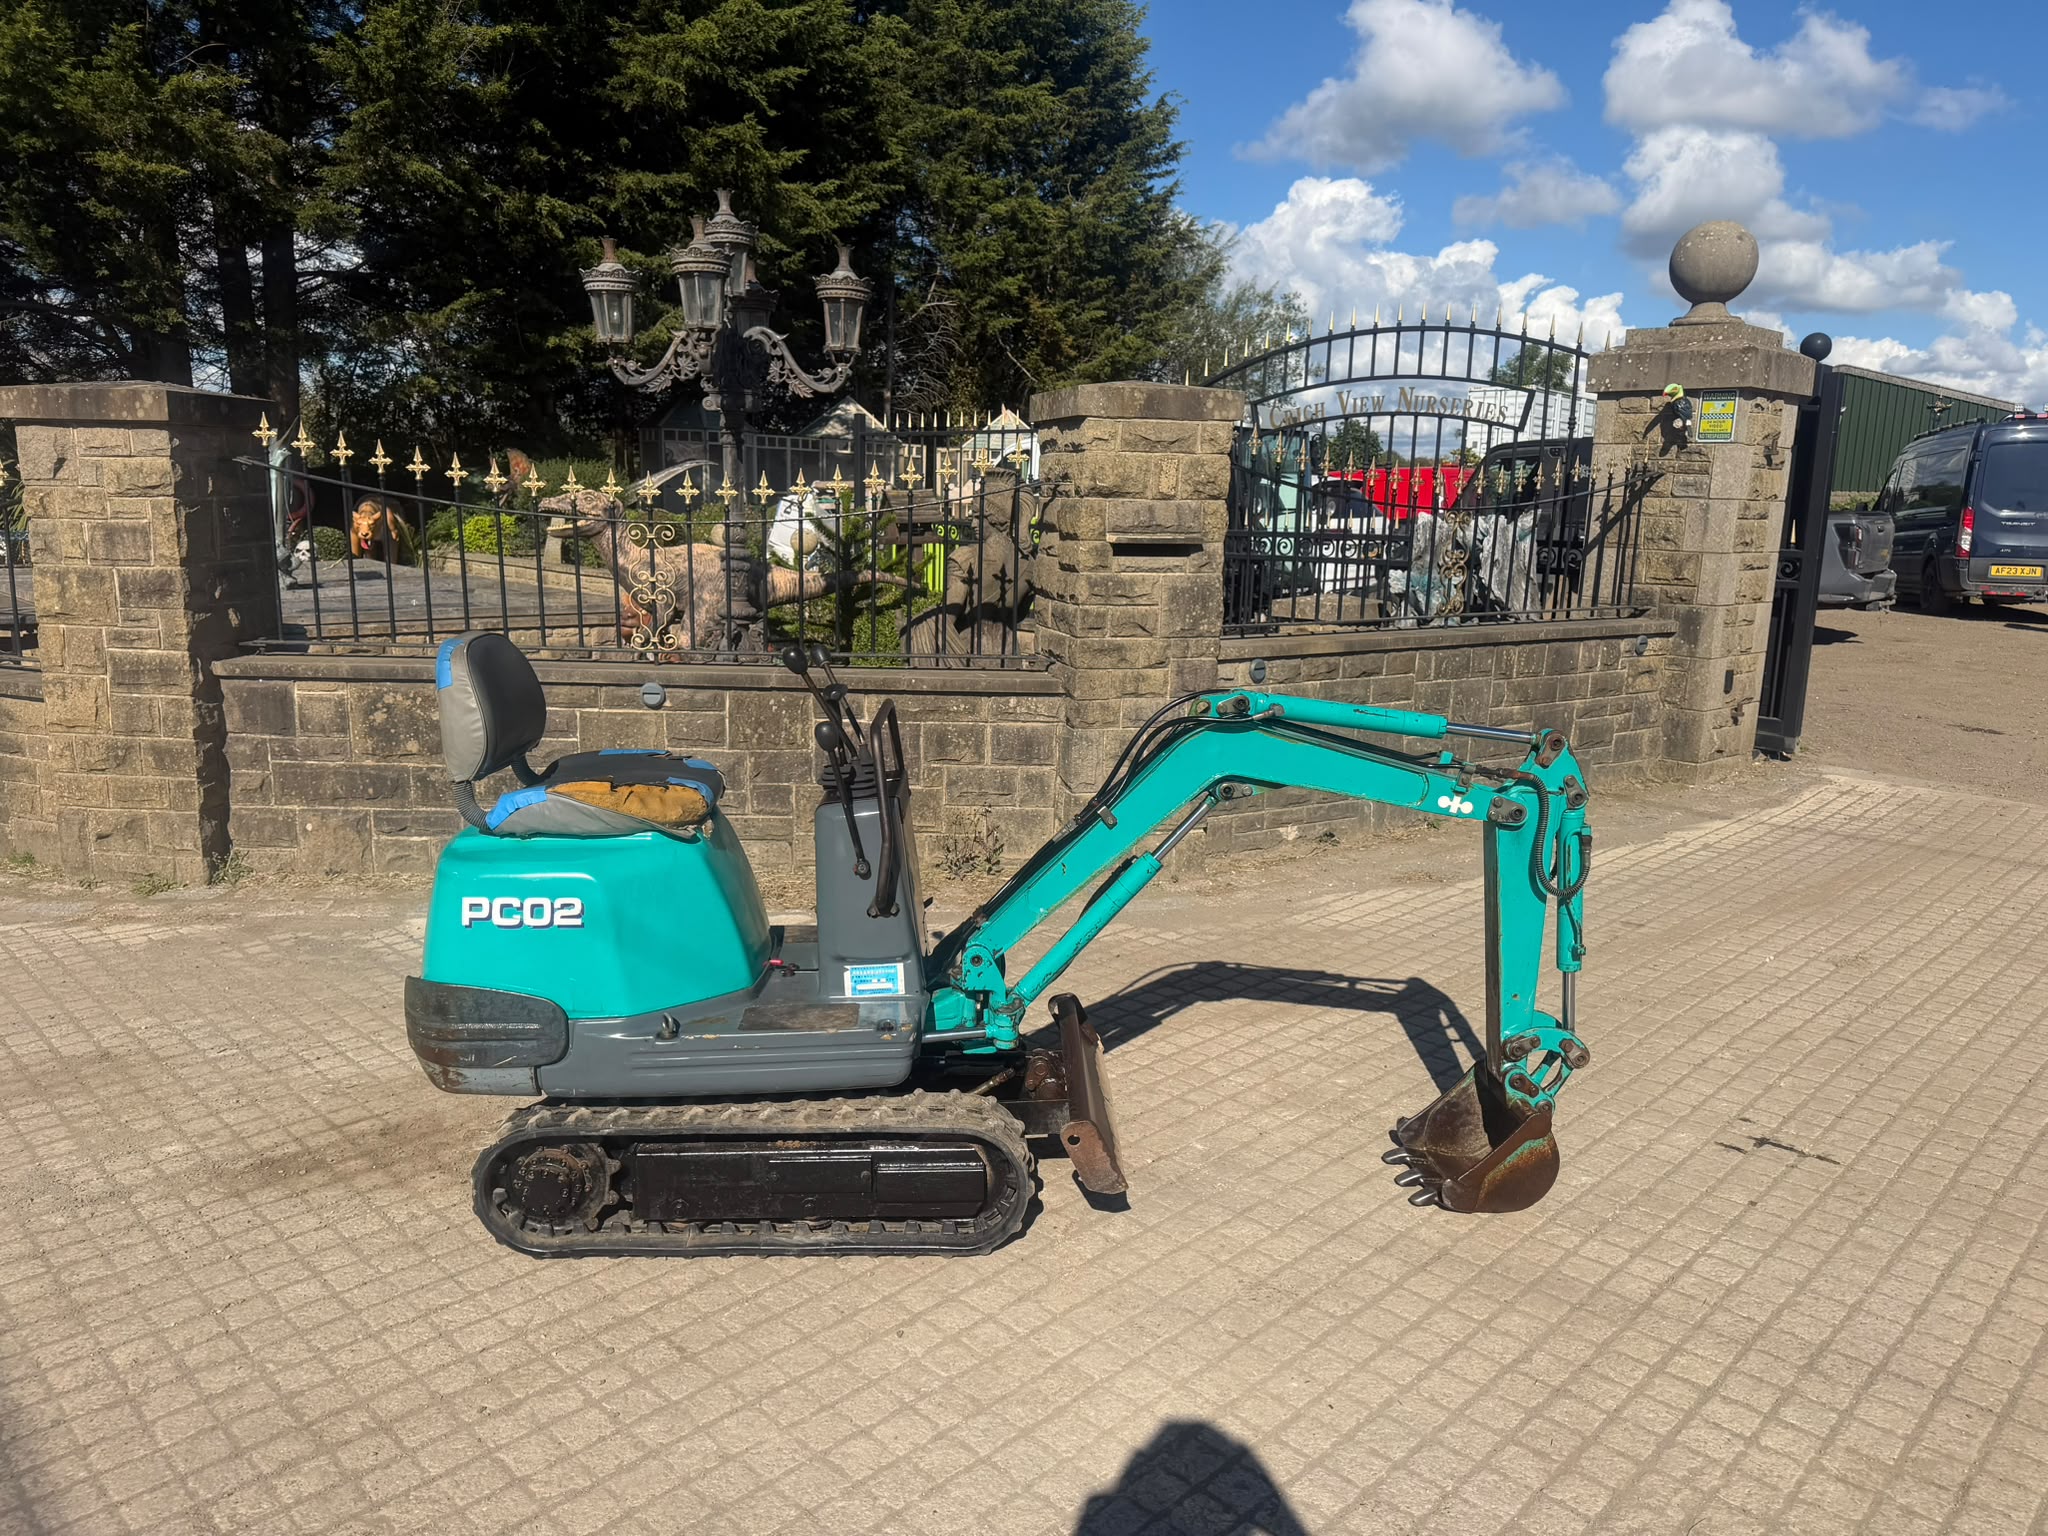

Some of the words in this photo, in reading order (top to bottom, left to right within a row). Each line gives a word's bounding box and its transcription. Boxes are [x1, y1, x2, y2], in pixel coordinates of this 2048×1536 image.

[1336, 389, 1385, 416] VIEW
[1394, 386, 1509, 424] NURSERIES
[1995, 567, 2018, 575] AF23
[461, 896, 584, 930] PC02
